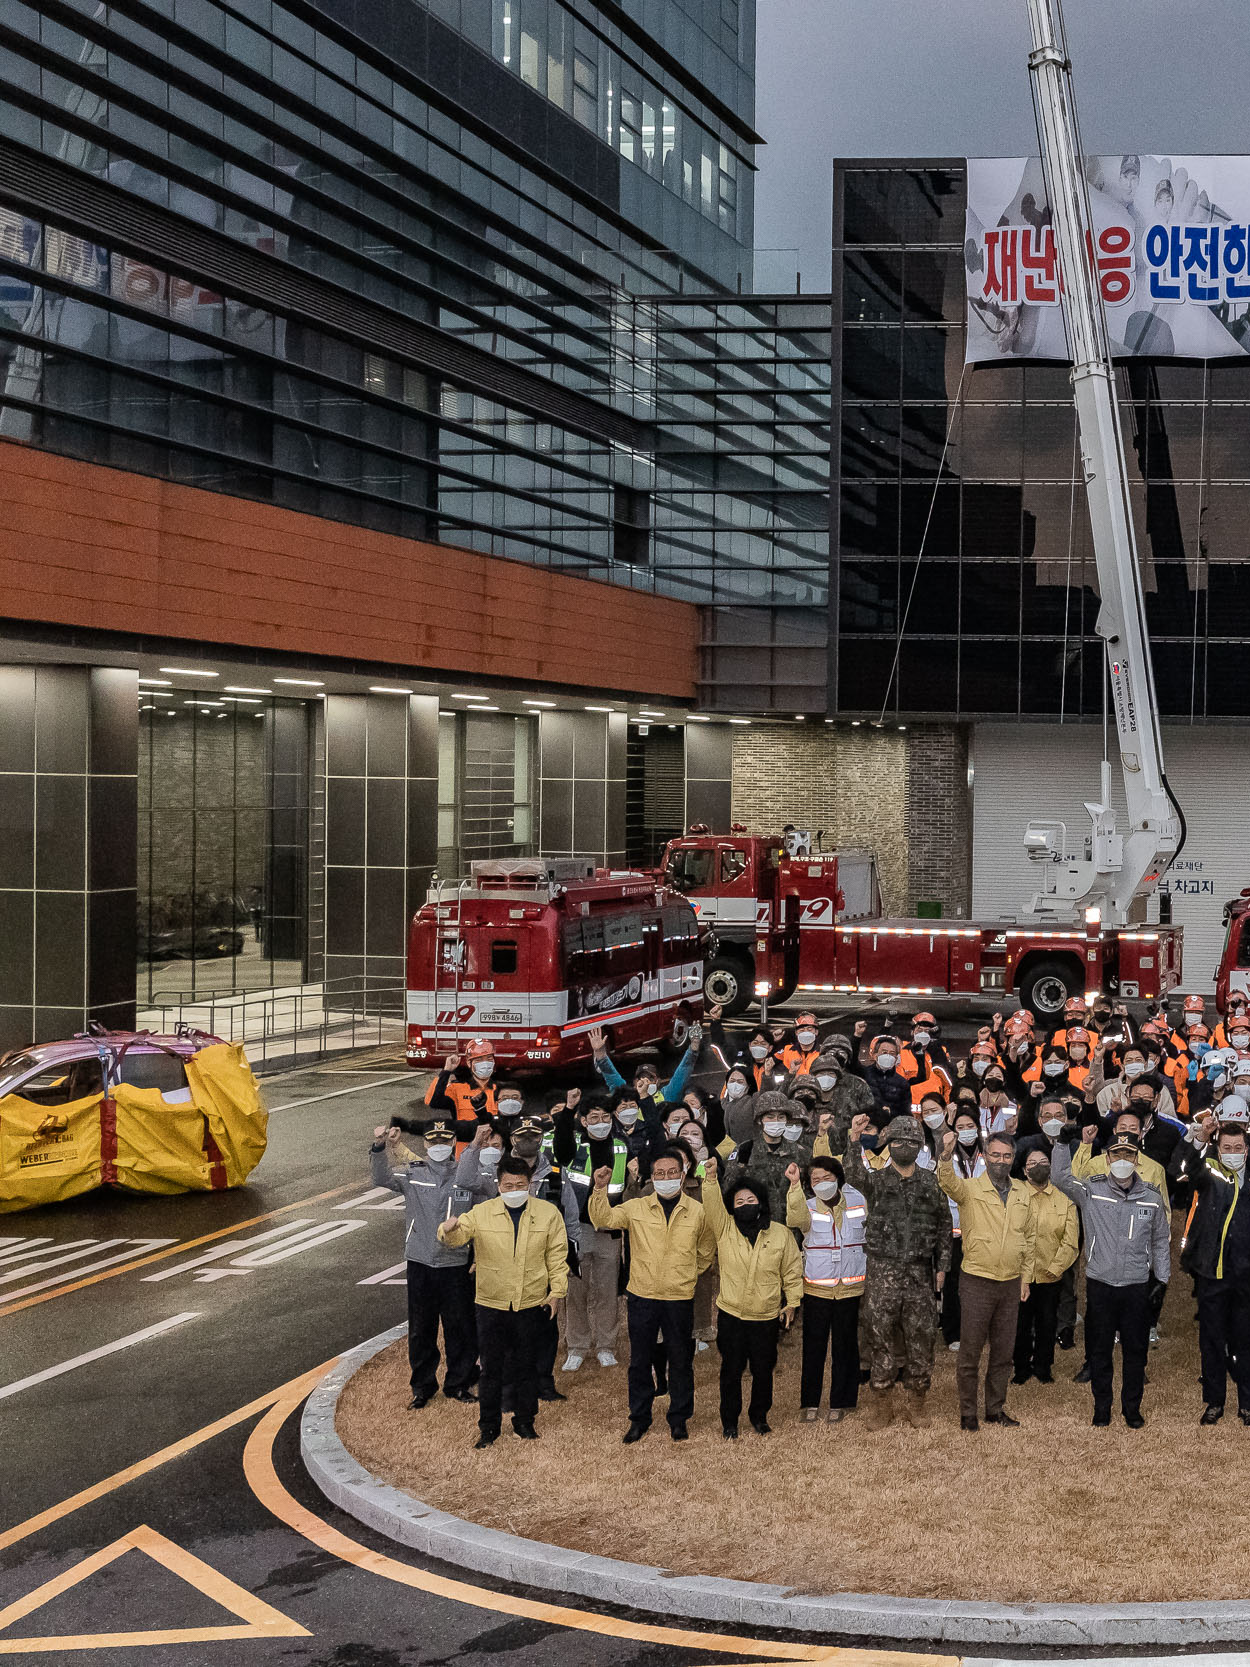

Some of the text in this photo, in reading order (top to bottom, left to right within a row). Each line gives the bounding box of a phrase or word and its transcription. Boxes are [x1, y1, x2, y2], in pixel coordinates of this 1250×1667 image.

[982, 226, 1134, 302] 재난응
[1174, 879, 1214, 895] 차고지
[435, 1005, 476, 1025] 119
[20, 1153, 49, 1165] WEBER
